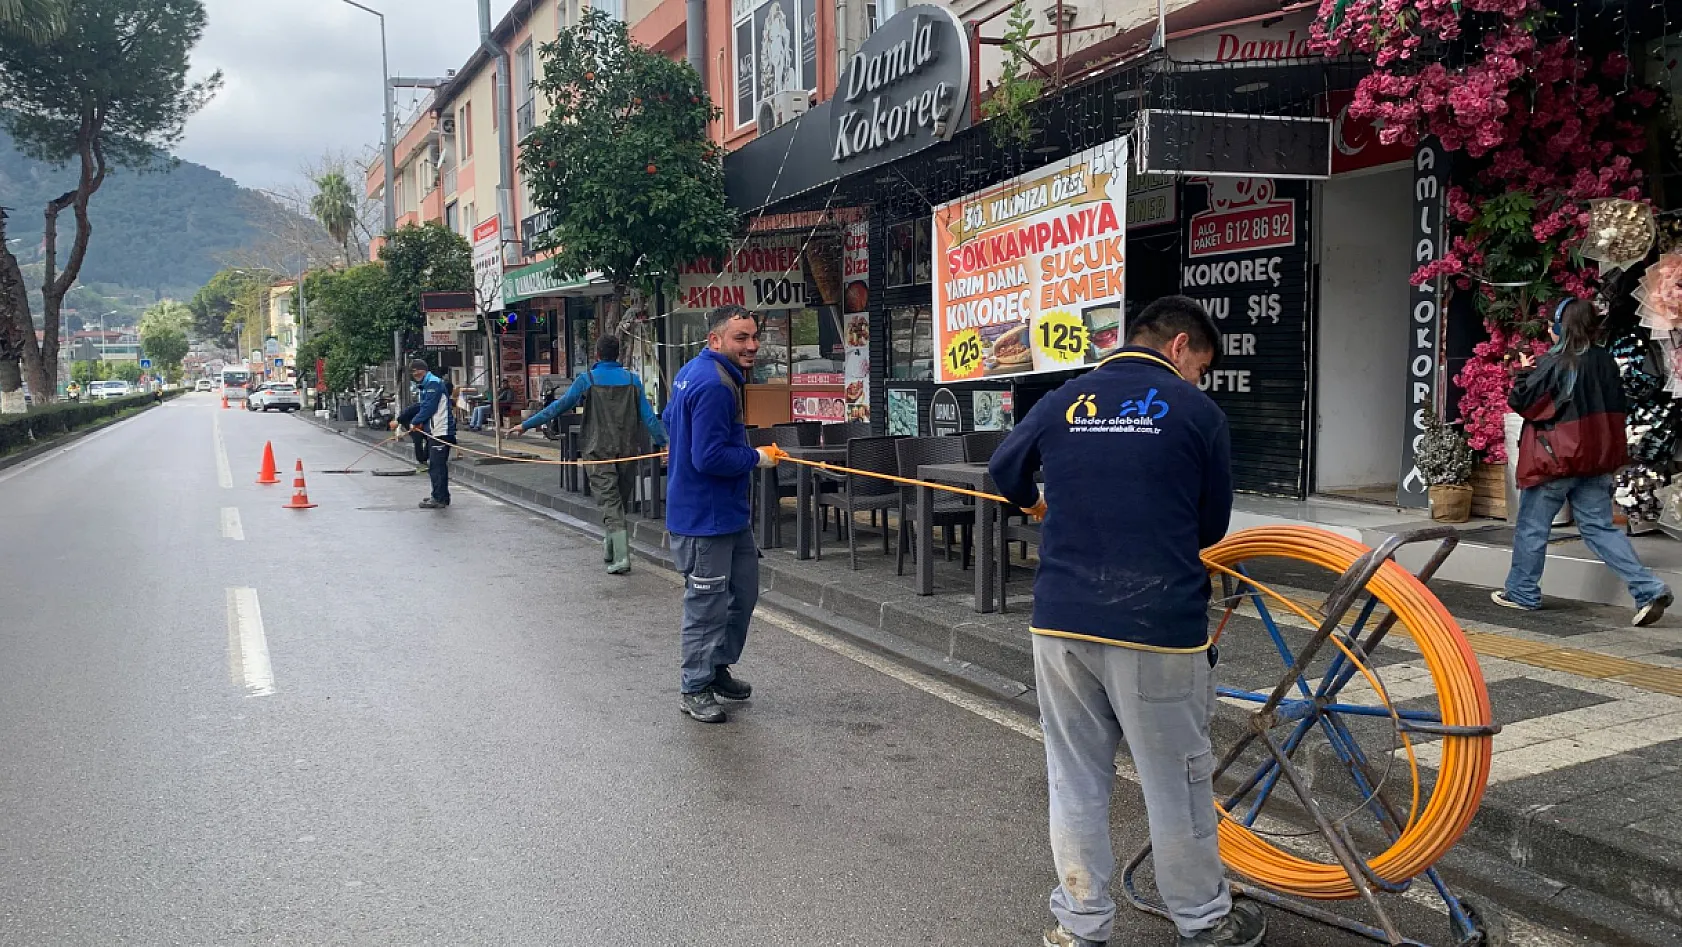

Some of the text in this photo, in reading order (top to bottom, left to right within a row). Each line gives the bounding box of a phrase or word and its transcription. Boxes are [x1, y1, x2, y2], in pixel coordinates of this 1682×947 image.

[844, 19, 932, 102] Damla
[1216, 30, 1310, 62] Damla
[963, 170, 1088, 232] 30. YILIMIZA ÖZEL
[1416, 147, 1437, 262] AMLA
[948, 202, 1120, 277] ŞOK KAMPANYA
[1194, 233, 1221, 250] PAKET
[1198, 222, 1216, 237] ALO
[1225, 213, 1290, 243] 612 86 92
[1040, 235, 1124, 282] SUCUK
[1184, 256, 1283, 287] KOKOREÇ
[945, 263, 1029, 301] YARIM DANA
[1040, 266, 1124, 311] EKMEK
[946, 290, 1031, 332] KOKOREÇ
[948, 335, 979, 369] 125
[1039, 322, 1083, 353] 125
[1058, 351, 1068, 360] TL
[1411, 278, 1436, 454] OKORE
